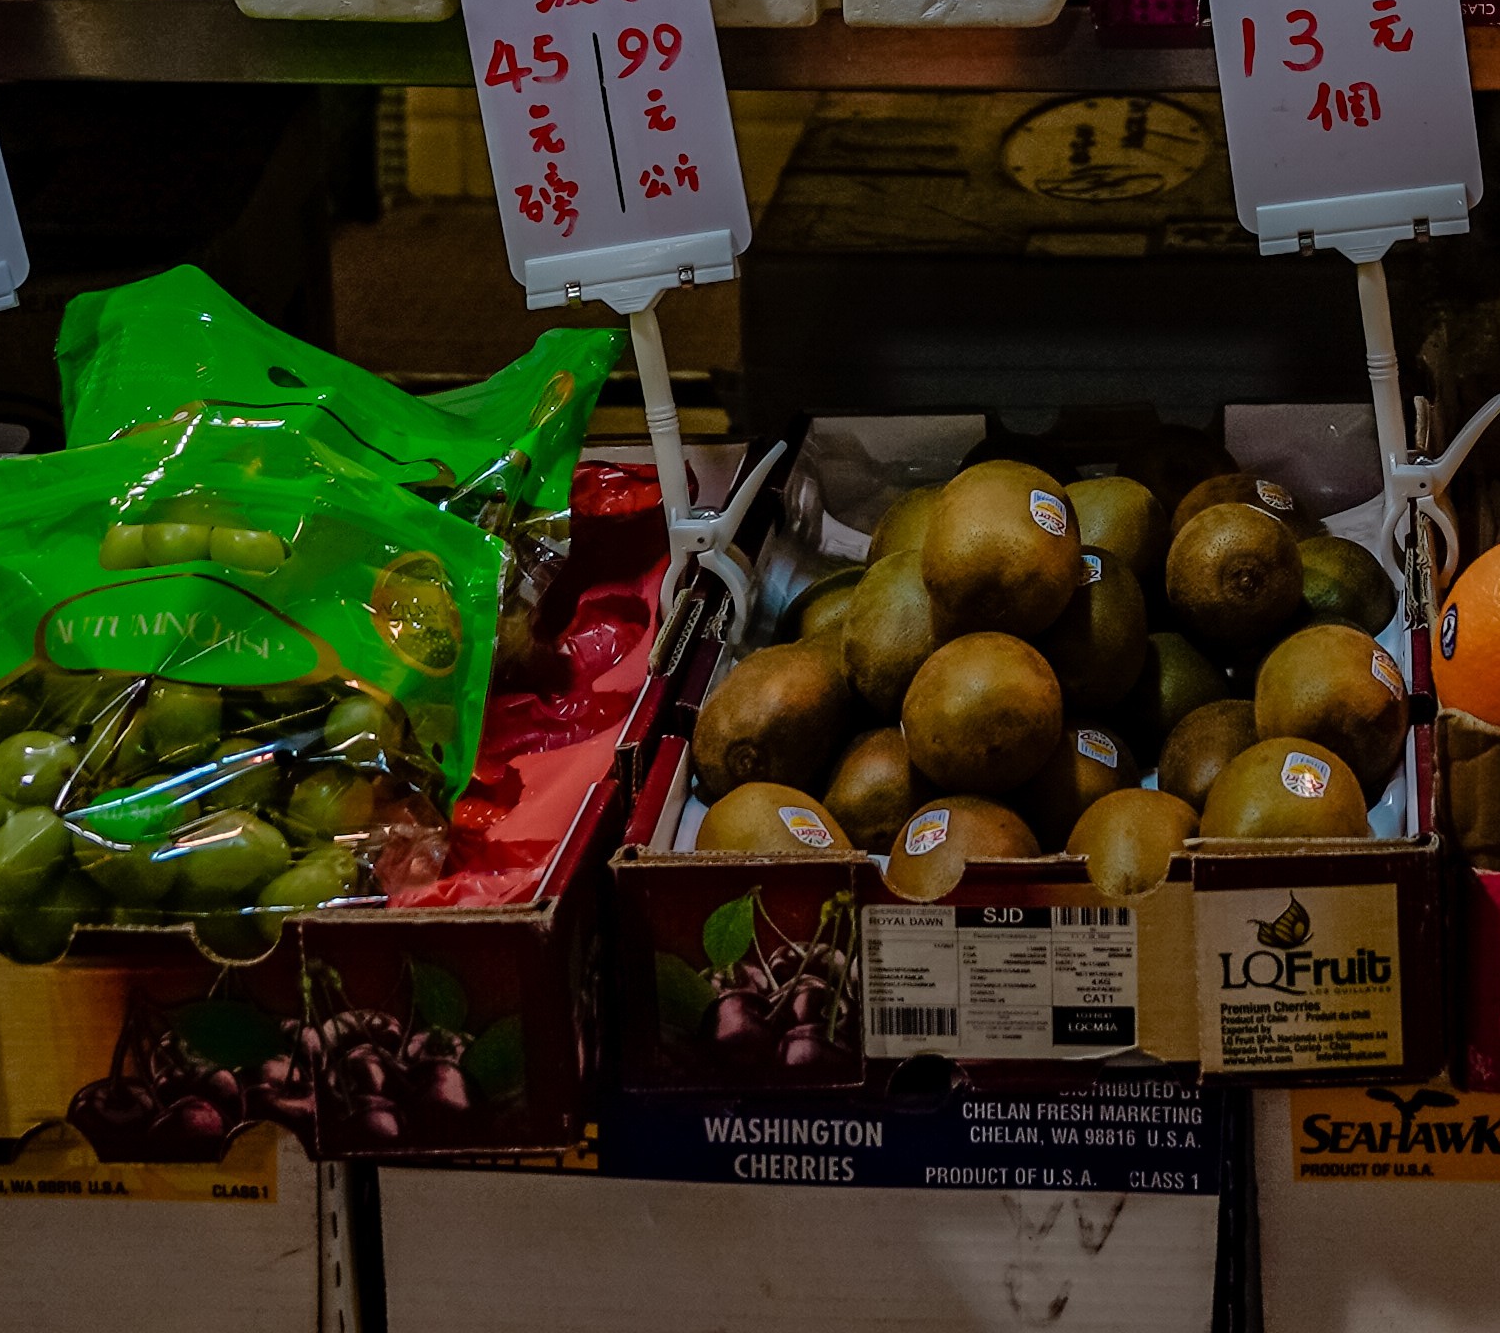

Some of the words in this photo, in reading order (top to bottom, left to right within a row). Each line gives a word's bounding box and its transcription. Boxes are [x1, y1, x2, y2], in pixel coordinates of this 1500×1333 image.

[484, 34, 569, 93] 45
[617, 22, 682, 79] 99
[1242, 9, 1324, 77] 13
[1308, 81, 1381, 131] 個
[909, 917, 944, 927] DAWN
[983, 907, 1024, 924] SJD
[1218, 948, 1391, 996] LQFruit
[961, 1102, 1032, 1123] CHELAN
[1036, 1102, 1095, 1123] FRESH
[1099, 1104, 1202, 1126] MARKETING
[702, 1116, 884, 1151] WASHINGTON
[969, 1126, 1045, 1147] CHELAN,
[1050, 1126, 1079, 1146] WA
[1084, 1126, 1136, 1147] 98816
[1147, 1128, 1202, 1149] U.S.A.
[732, 1153, 856, 1184] CHERRIES
[924, 1165, 1010, 1186] PRODUCT
[1014, 1165, 1038, 1186] OF
[1042, 1167, 1099, 1188] U.S.A.
[1129, 1169, 1183, 1190] CLASS
[1189, 1171, 1200, 1191] 1
